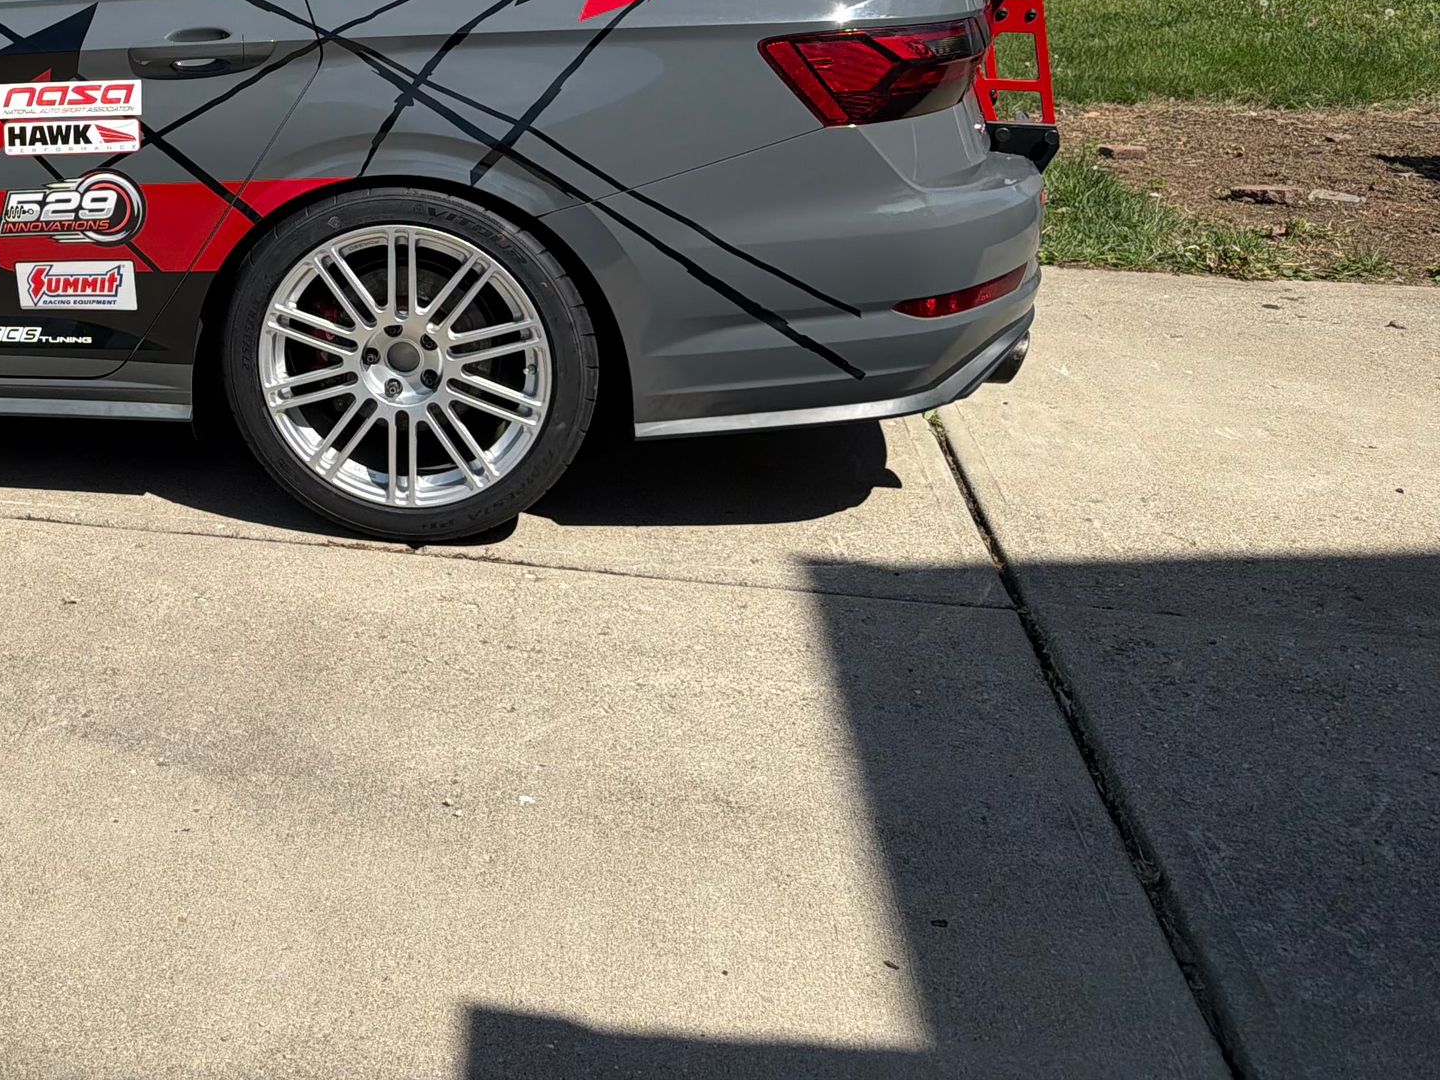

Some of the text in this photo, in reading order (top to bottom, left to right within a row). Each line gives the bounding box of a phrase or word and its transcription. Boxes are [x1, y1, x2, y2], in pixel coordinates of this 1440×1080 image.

[7, 124, 92, 147] HAWK
[7, 144, 137, 153] PERFORMANCE
[6, 190, 117, 222] 529
[3, 220, 109, 232] INNOVATIONS
